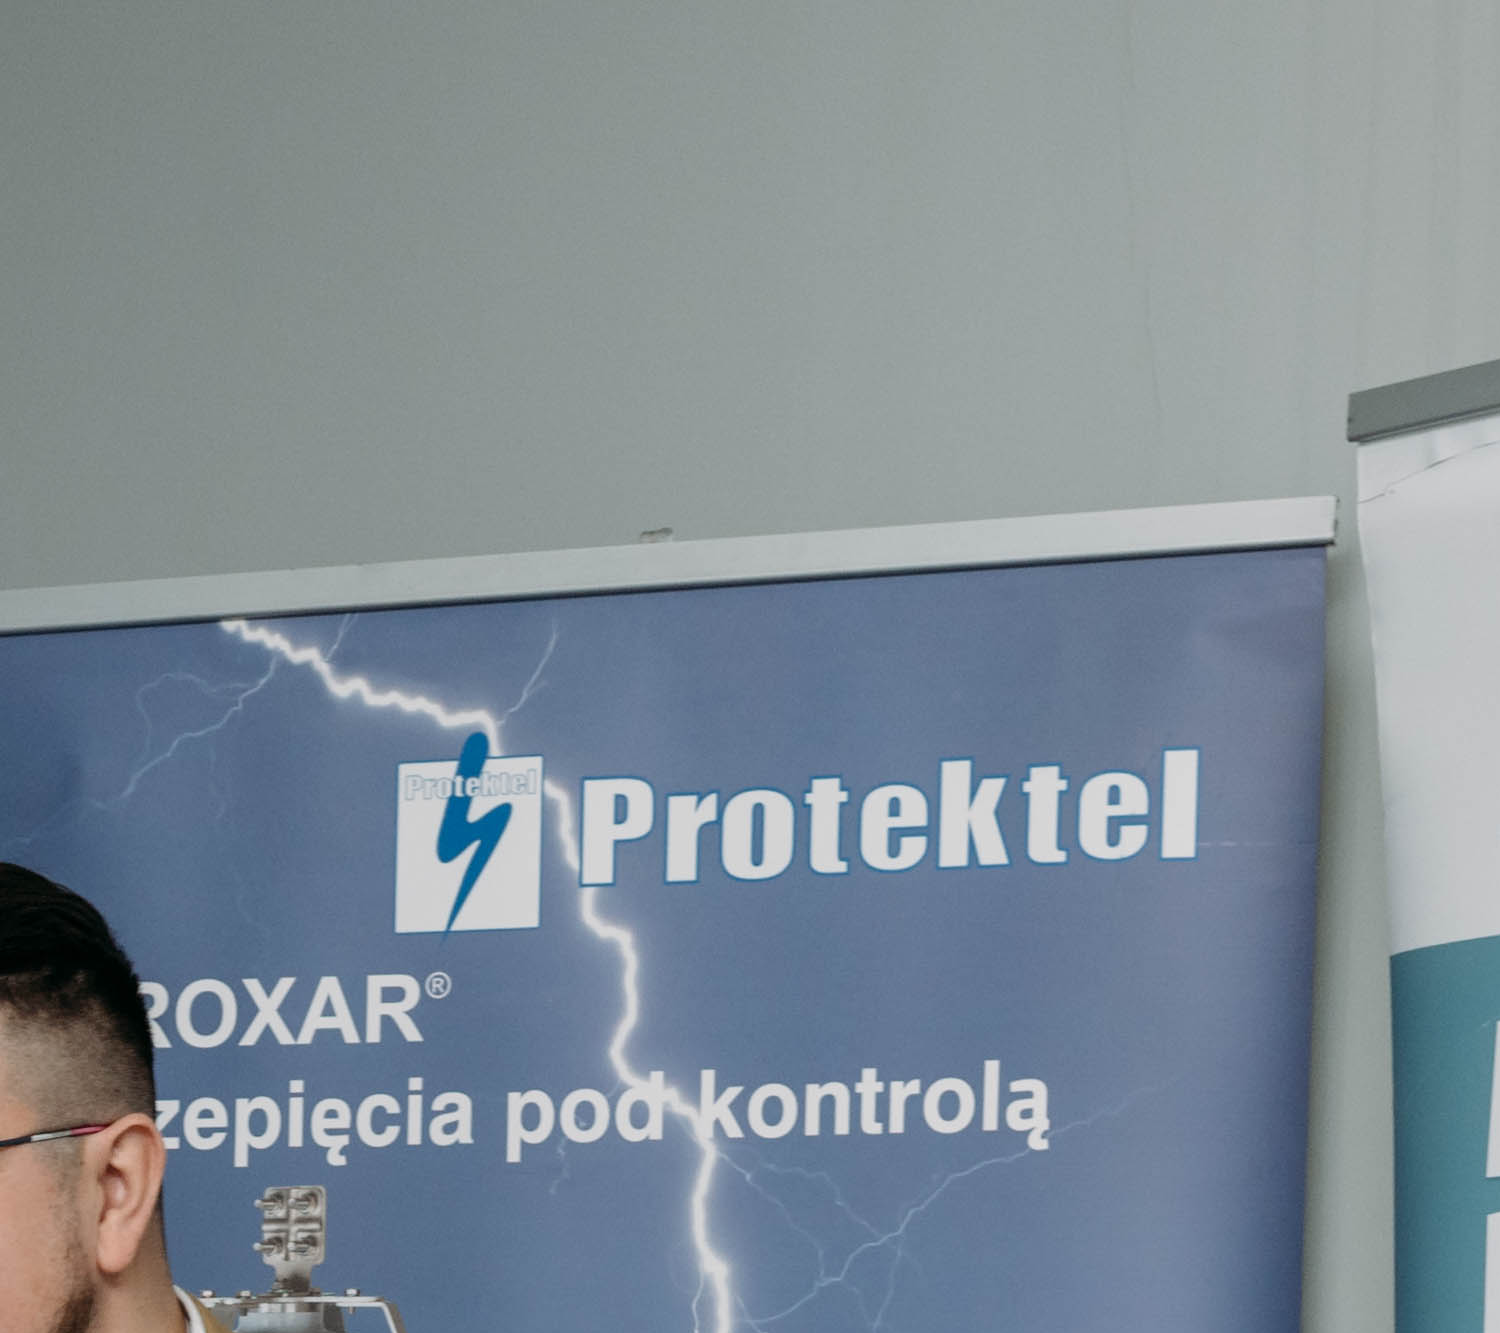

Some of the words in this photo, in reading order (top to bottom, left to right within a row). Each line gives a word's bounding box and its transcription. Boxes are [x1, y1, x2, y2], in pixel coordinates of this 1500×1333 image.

[402, 764, 541, 802] Protektel
[578, 746, 1202, 888] Protektel
[504, 1078, 668, 1164] pod
[696, 1058, 1052, 1152] kontrolą
